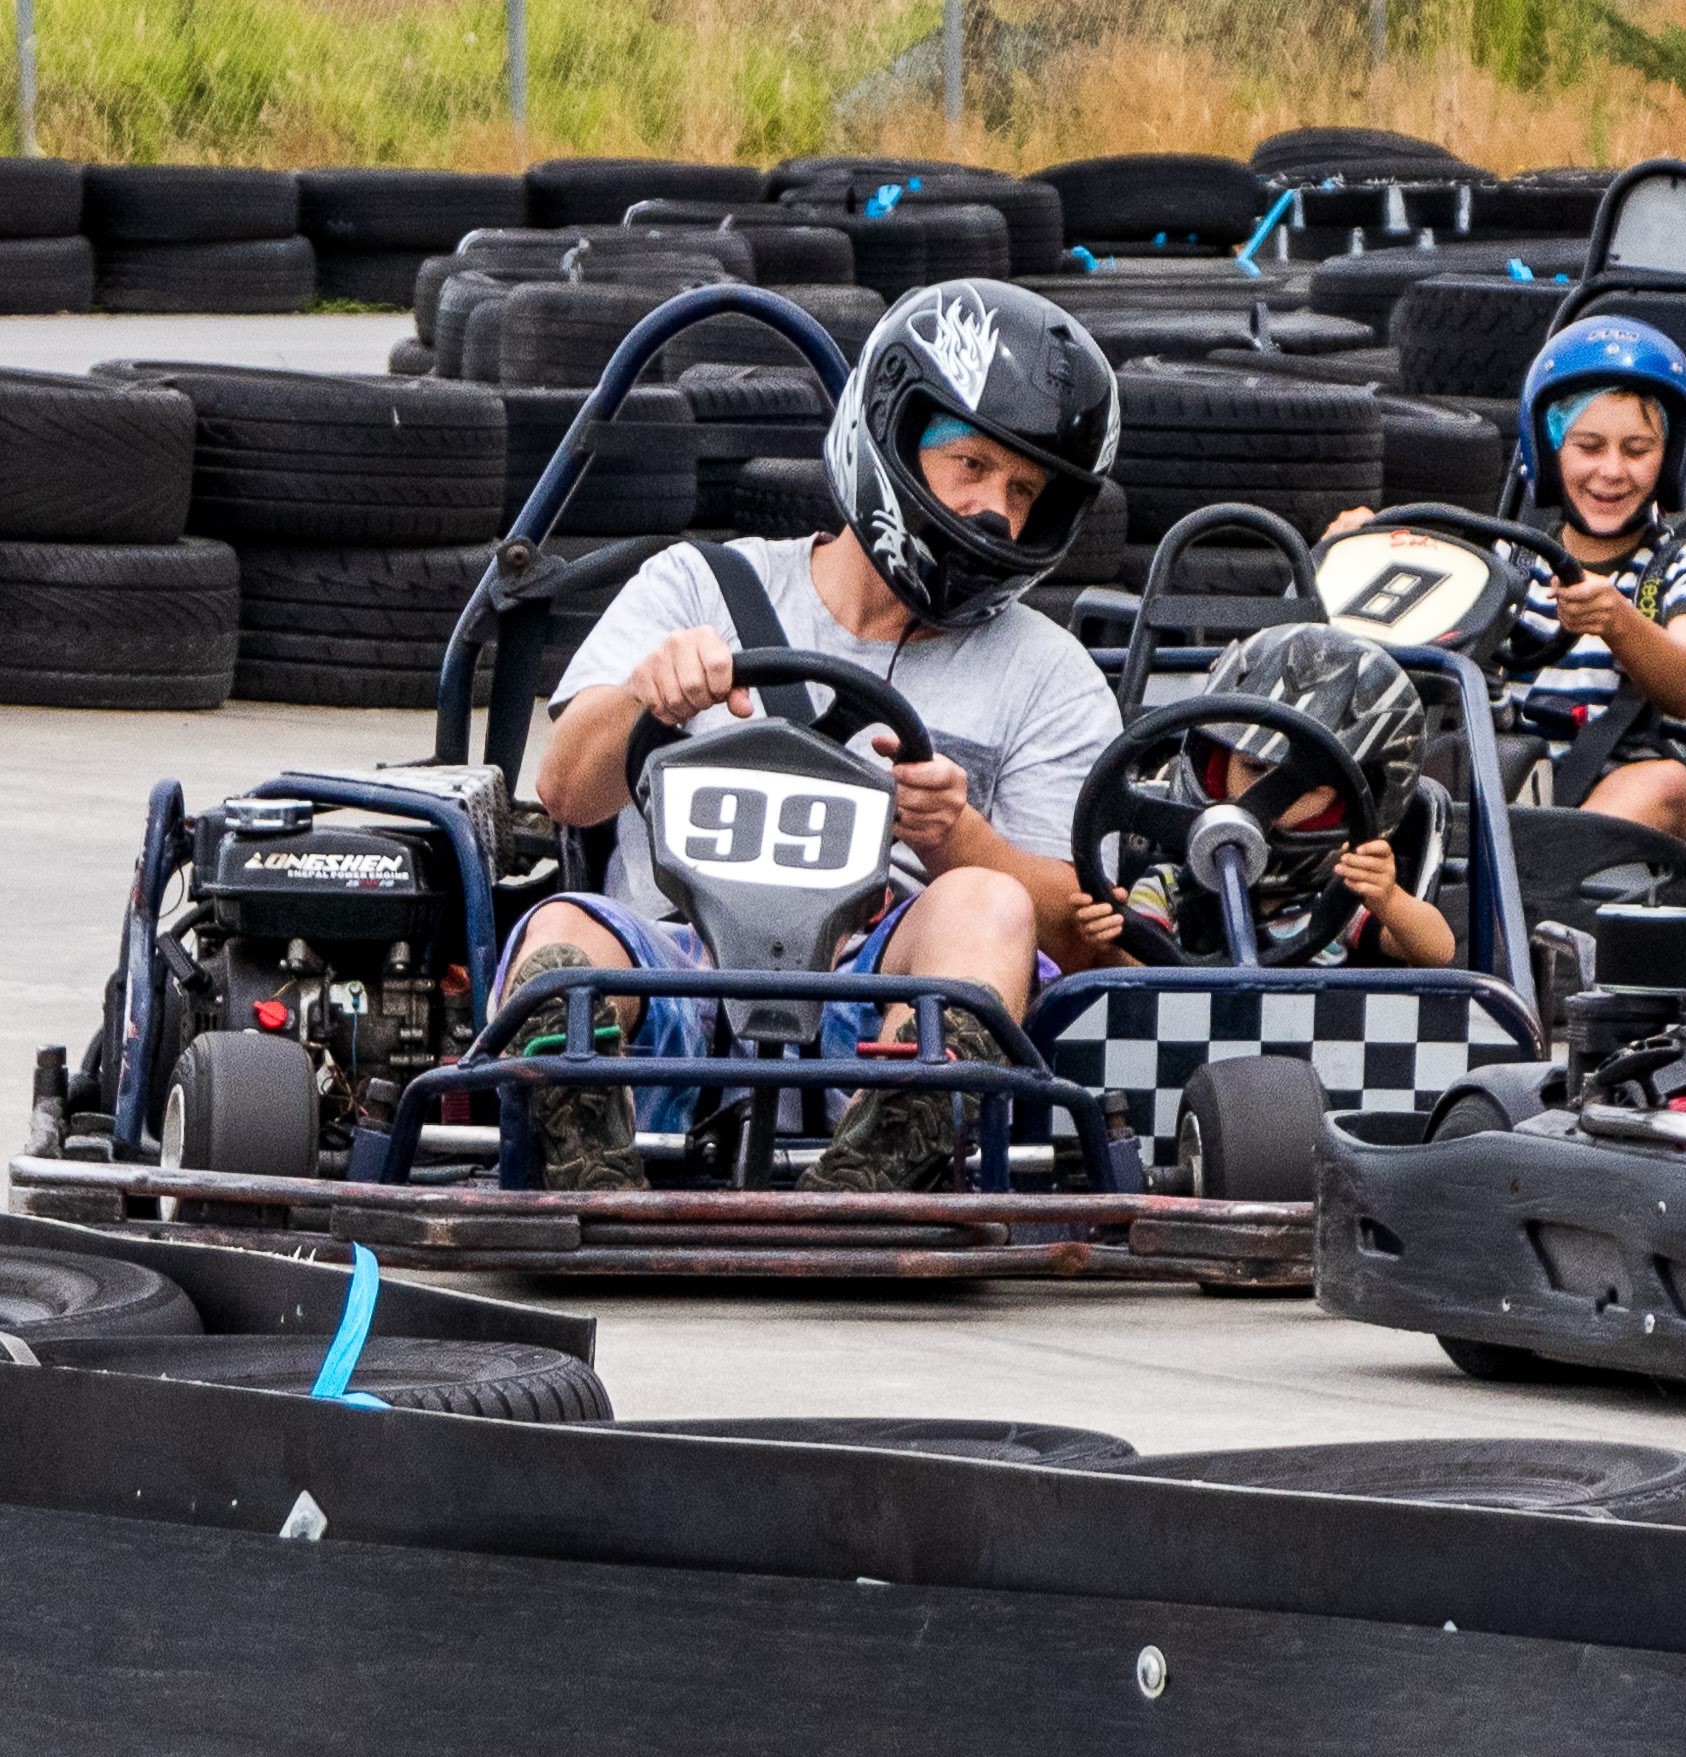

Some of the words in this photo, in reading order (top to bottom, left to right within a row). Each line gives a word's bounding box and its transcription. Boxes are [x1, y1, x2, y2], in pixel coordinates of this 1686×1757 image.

[1333, 560, 1454, 629] 8
[244, 852, 404, 872] LONGSHEN
[684, 786, 858, 871] 99
